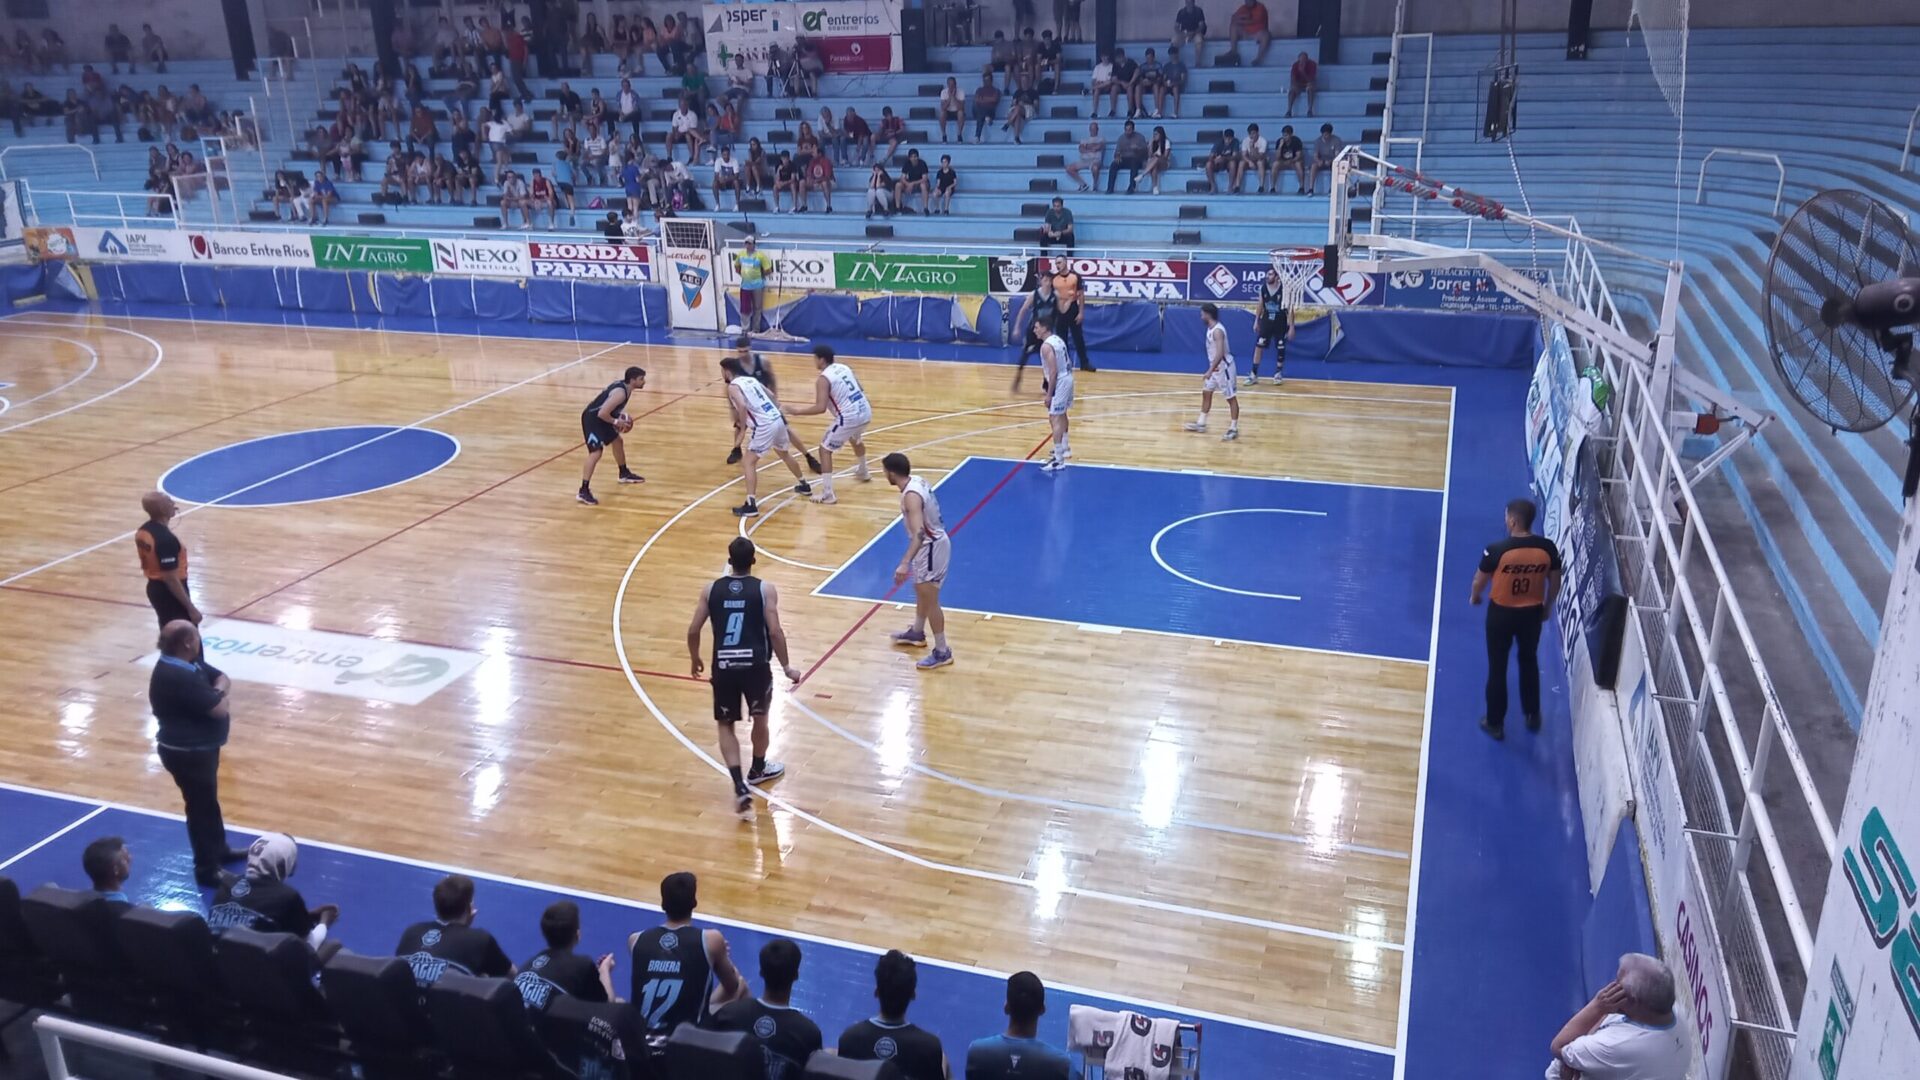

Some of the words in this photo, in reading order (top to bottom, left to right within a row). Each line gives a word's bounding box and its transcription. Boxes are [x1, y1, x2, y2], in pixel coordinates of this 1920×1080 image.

[126, 234, 147, 244] IAPV
[213, 242, 248, 256] Banco
[250, 243, 282, 257] Entre
[461, 248, 518, 263] NEXO
[538, 243, 639, 260] HONDA
[535, 261, 647, 280] PARANA
[1001, 265, 1025, 274] Rock
[1005, 277, 1023, 286] Gol
[1084, 281, 1183, 299] RANA
[842, 376, 855, 392] 5
[754, 386, 766, 402] 4
[1502, 564, 1548, 574] ESCO
[723, 612, 744, 646] 9
[648, 959, 681, 973] BRUERA
[1677, 901, 1713, 1056] CASINOS
